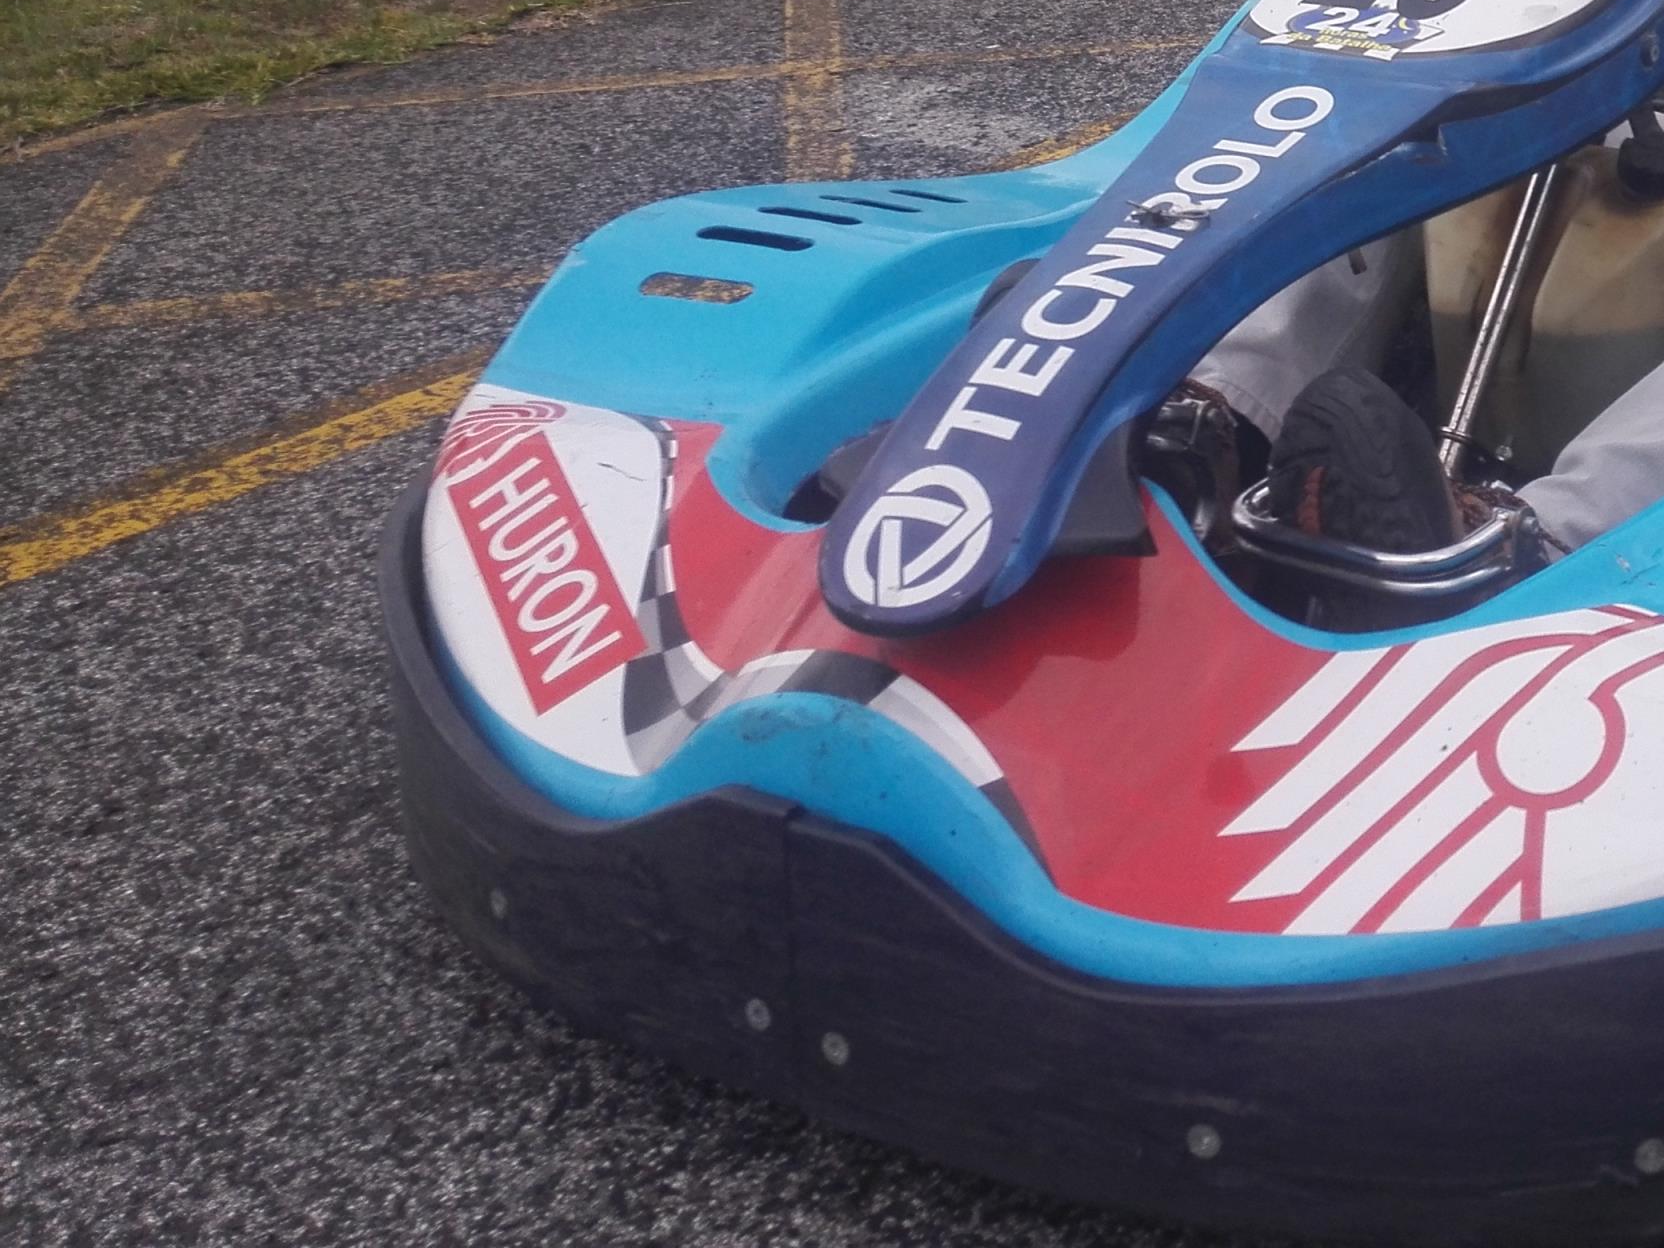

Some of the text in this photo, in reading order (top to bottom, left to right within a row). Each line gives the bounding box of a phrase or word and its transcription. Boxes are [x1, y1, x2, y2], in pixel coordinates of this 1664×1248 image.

[1305, 7, 1400, 38] 24
[923, 85, 1336, 452] TECNIROLO
[468, 456, 624, 685] HURON
